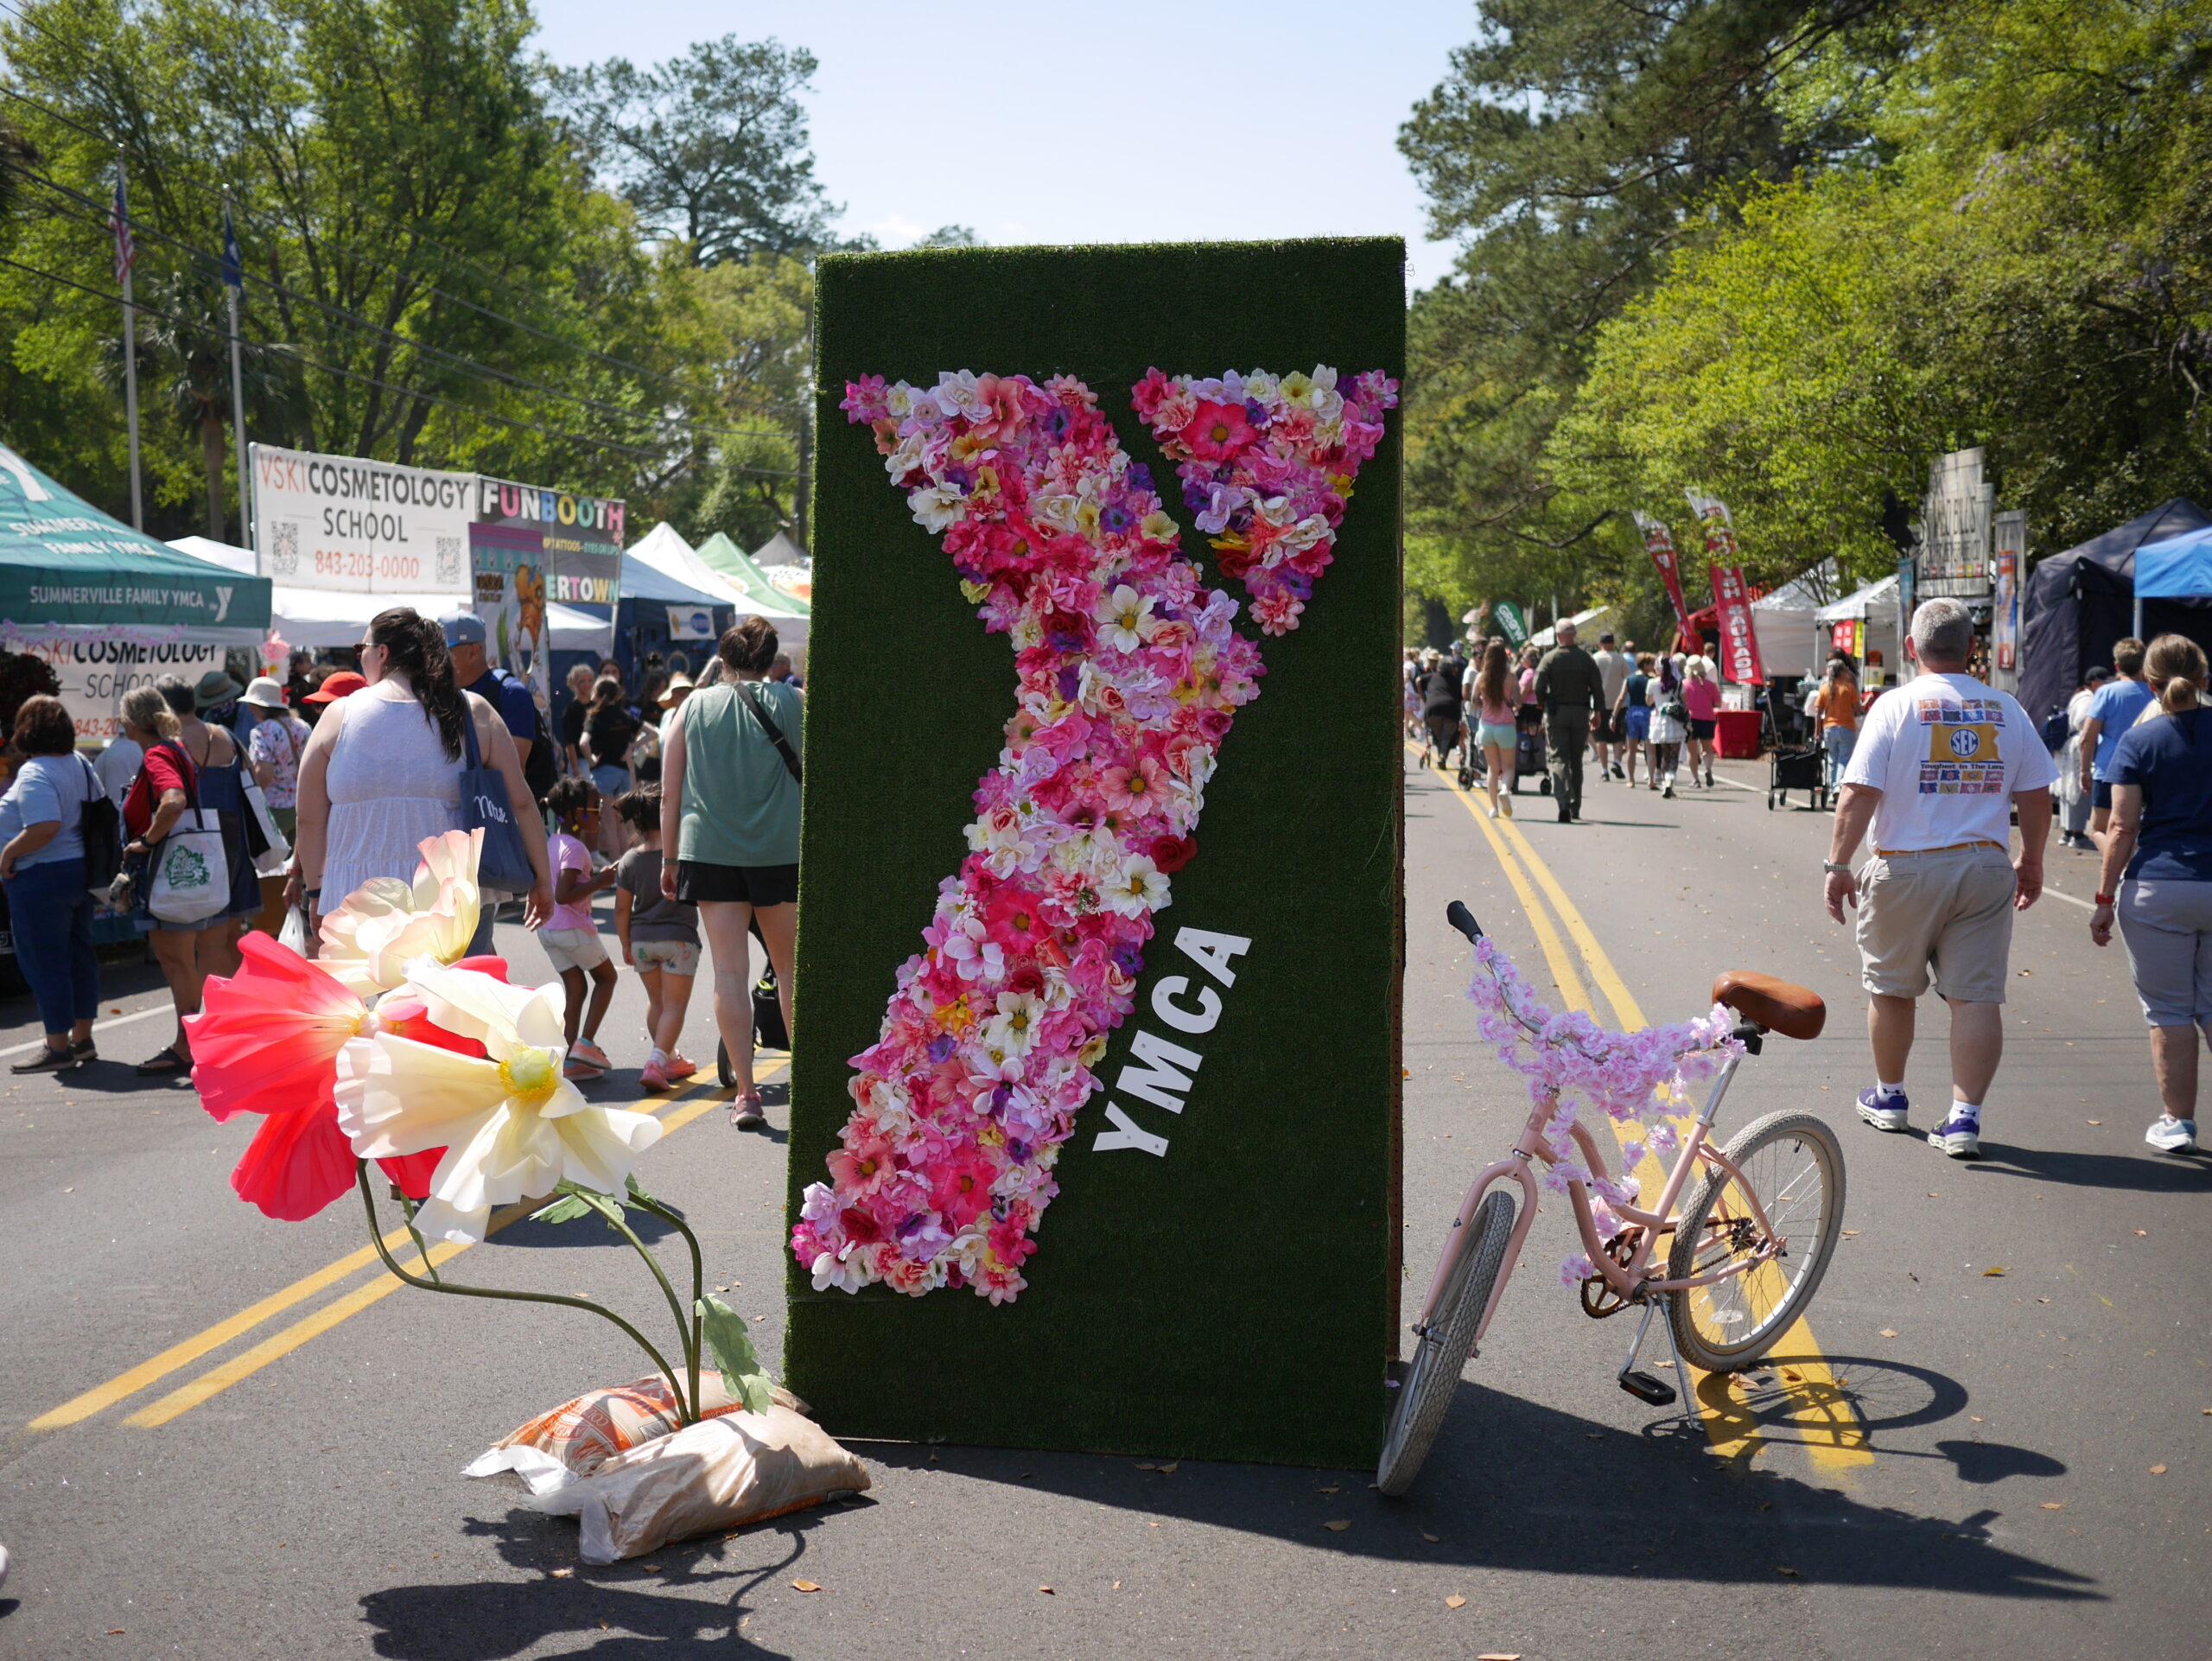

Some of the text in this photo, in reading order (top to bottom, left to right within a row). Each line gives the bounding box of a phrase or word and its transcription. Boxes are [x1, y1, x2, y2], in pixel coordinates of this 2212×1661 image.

[308, 461, 469, 510] COSMETOLOGY
[483, 481, 623, 531] FUNBOOTH
[9, 518, 131, 537] SUMMERV
[323, 507, 408, 542] SCHOOL
[44, 540, 161, 556] FAMILY YMCA
[315, 550, 419, 580] 843-203-0000
[30, 586, 122, 604] SUMMERVILLE
[126, 589, 168, 606] FAMILY
[171, 590, 204, 608] YMCA
[86, 673, 158, 699] SCHOO
[1951, 729, 1978, 756] SEC
[474, 794, 508, 824] Mrs.
[1092, 926, 1252, 1157] YMCA
